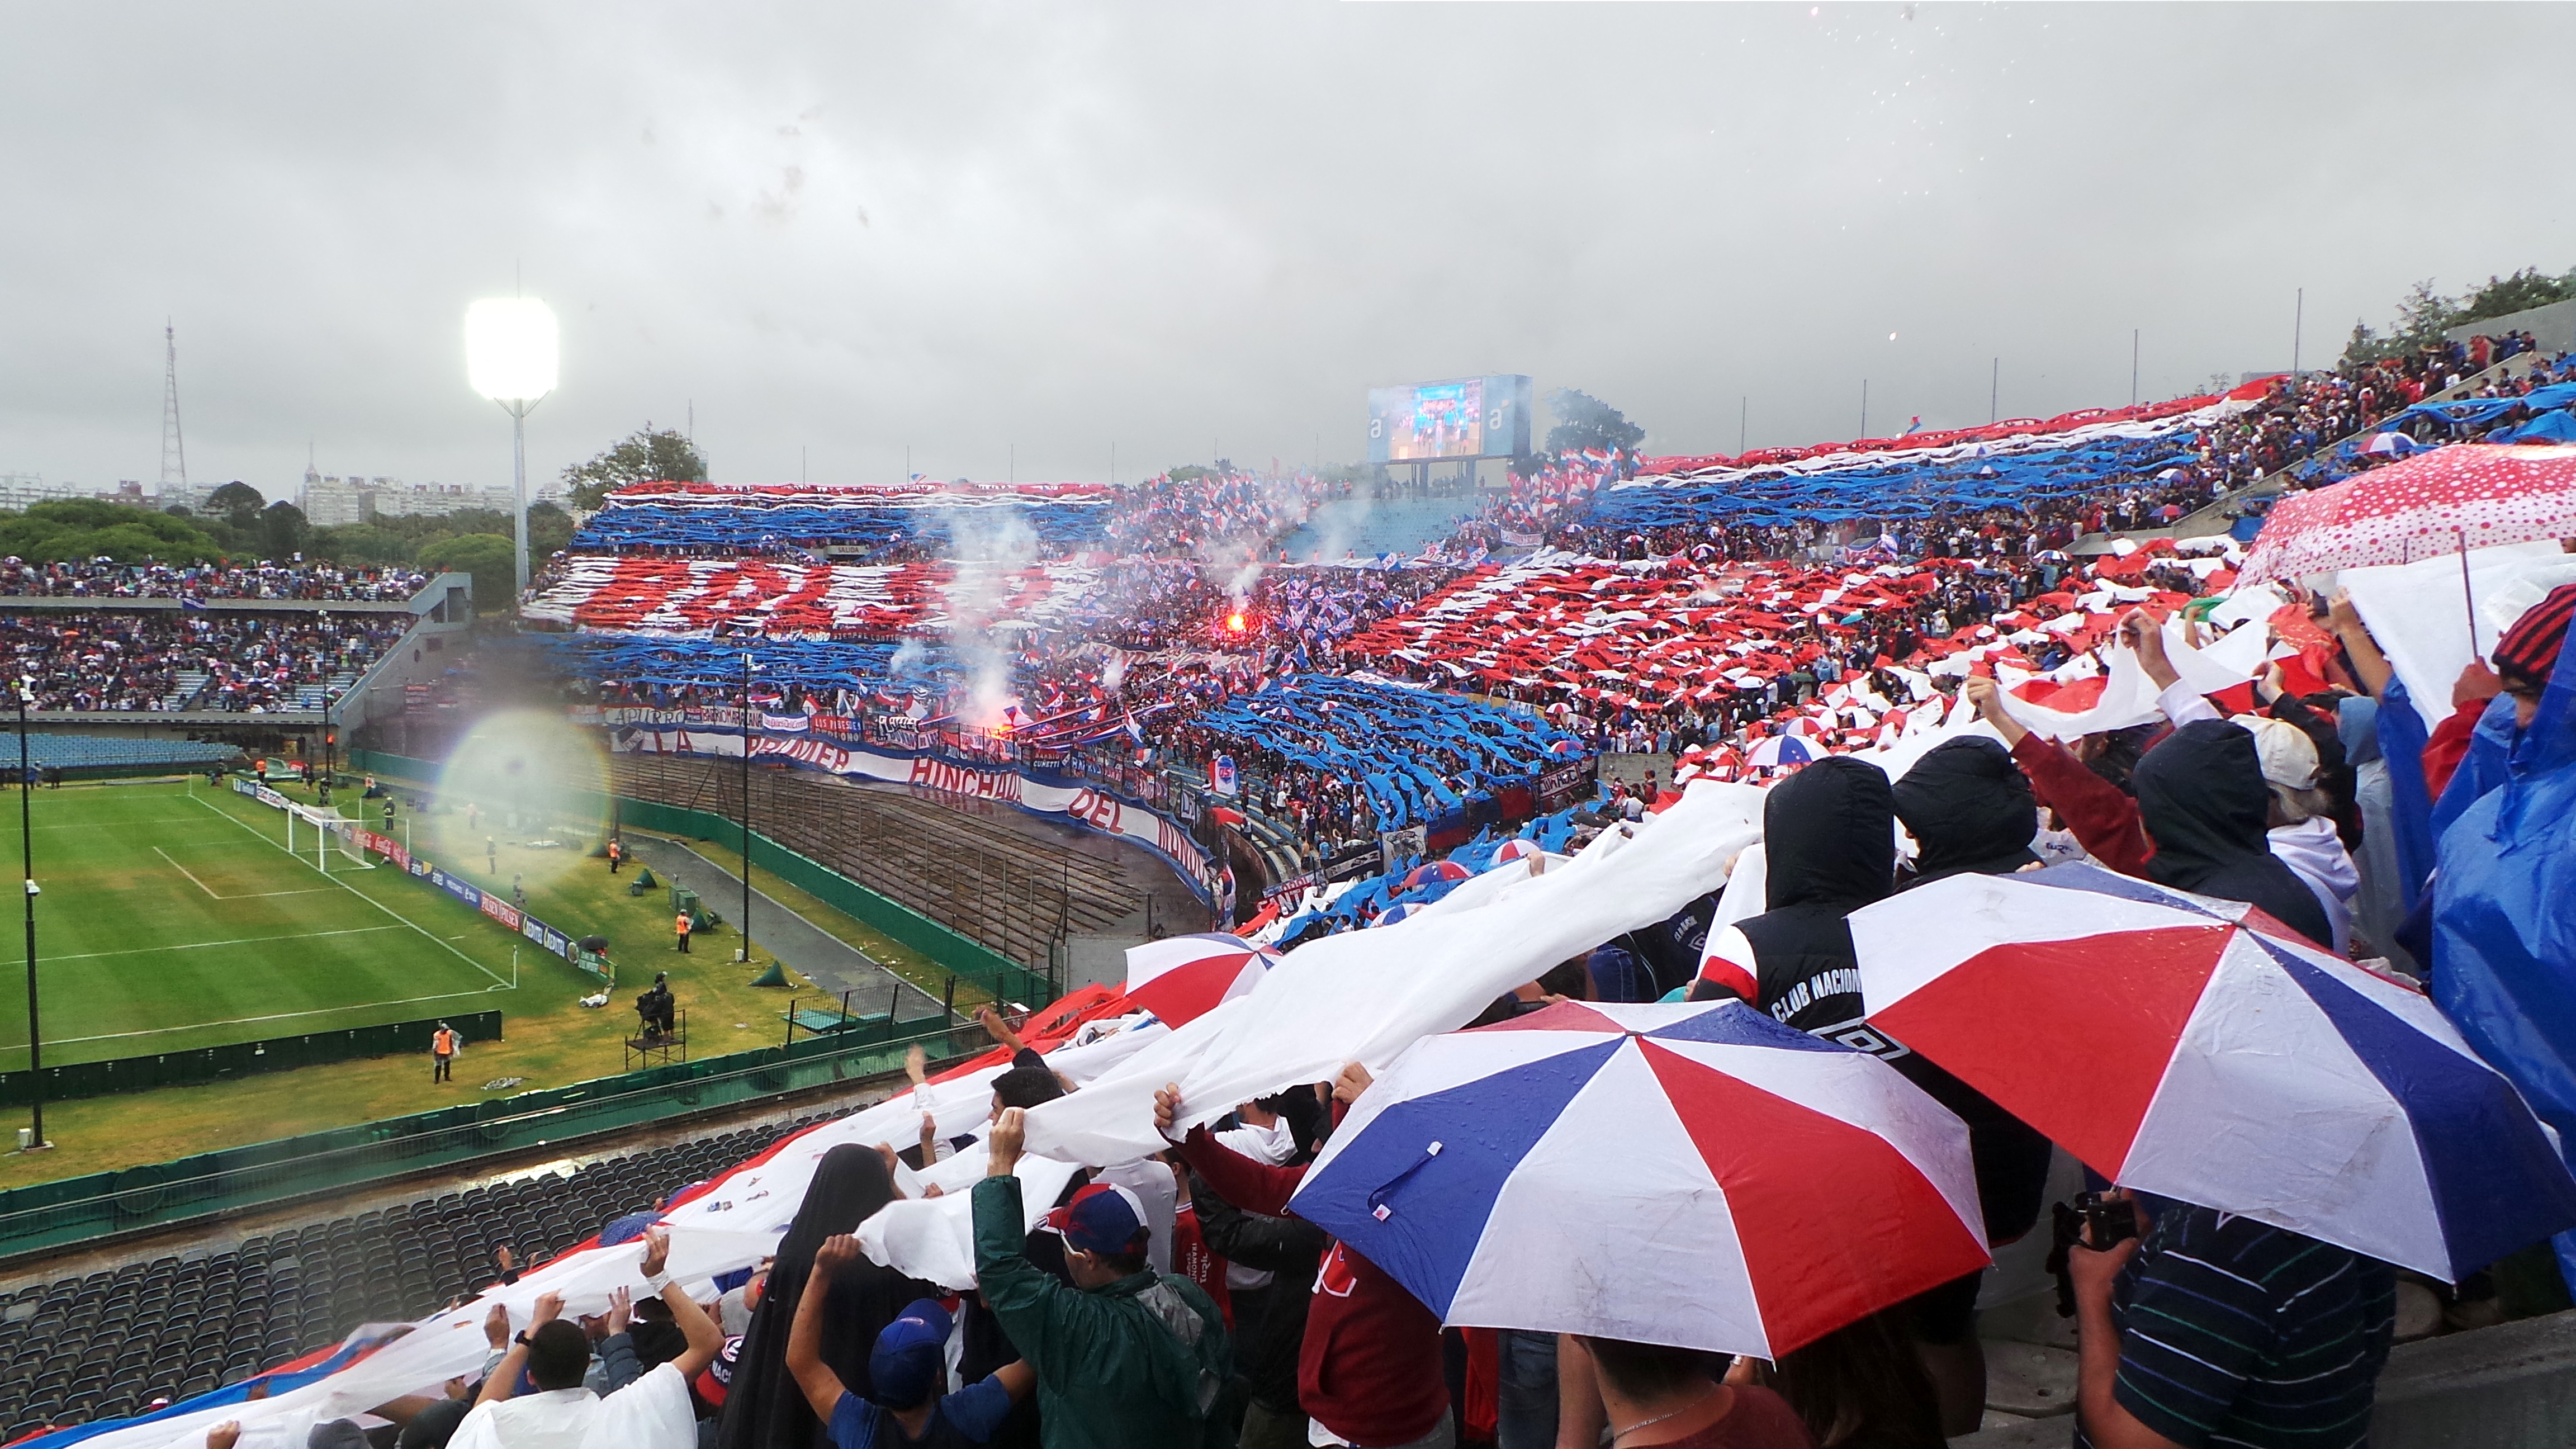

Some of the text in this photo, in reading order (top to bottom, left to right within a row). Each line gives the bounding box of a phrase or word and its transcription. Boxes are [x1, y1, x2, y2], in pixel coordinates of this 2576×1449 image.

[815, 718, 827, 727] LOS
[654, 727, 693, 756] LA
[908, 756, 1023, 806] HINCHADA
[1068, 786, 1124, 835] DEL
[482, 896, 499, 916] PILSEN
[501, 906, 518, 927] PILSEN
[1771, 982, 1810, 1023] CLUB
